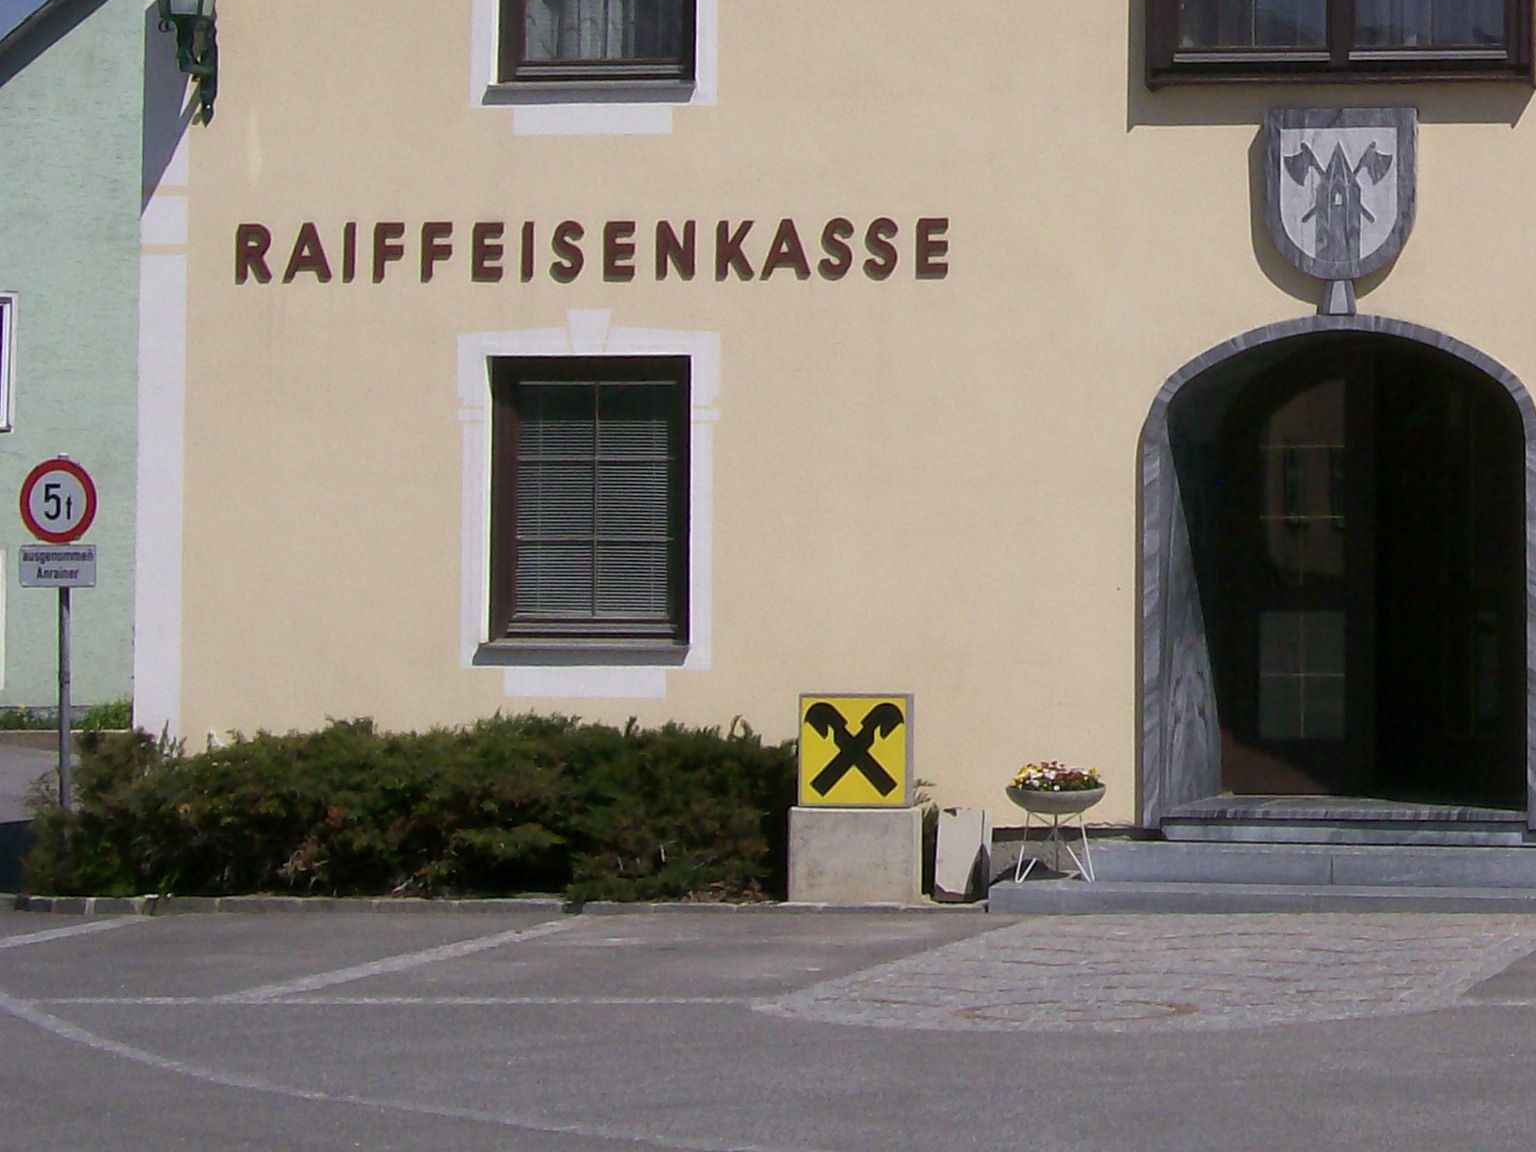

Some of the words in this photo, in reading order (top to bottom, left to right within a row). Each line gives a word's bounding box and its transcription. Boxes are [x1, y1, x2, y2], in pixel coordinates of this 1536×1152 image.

[234, 216, 950, 286] RAIFFEISENKASSE
[22, 550, 94, 564] ausgenommen
[36, 566, 80, 579] Anrainer
